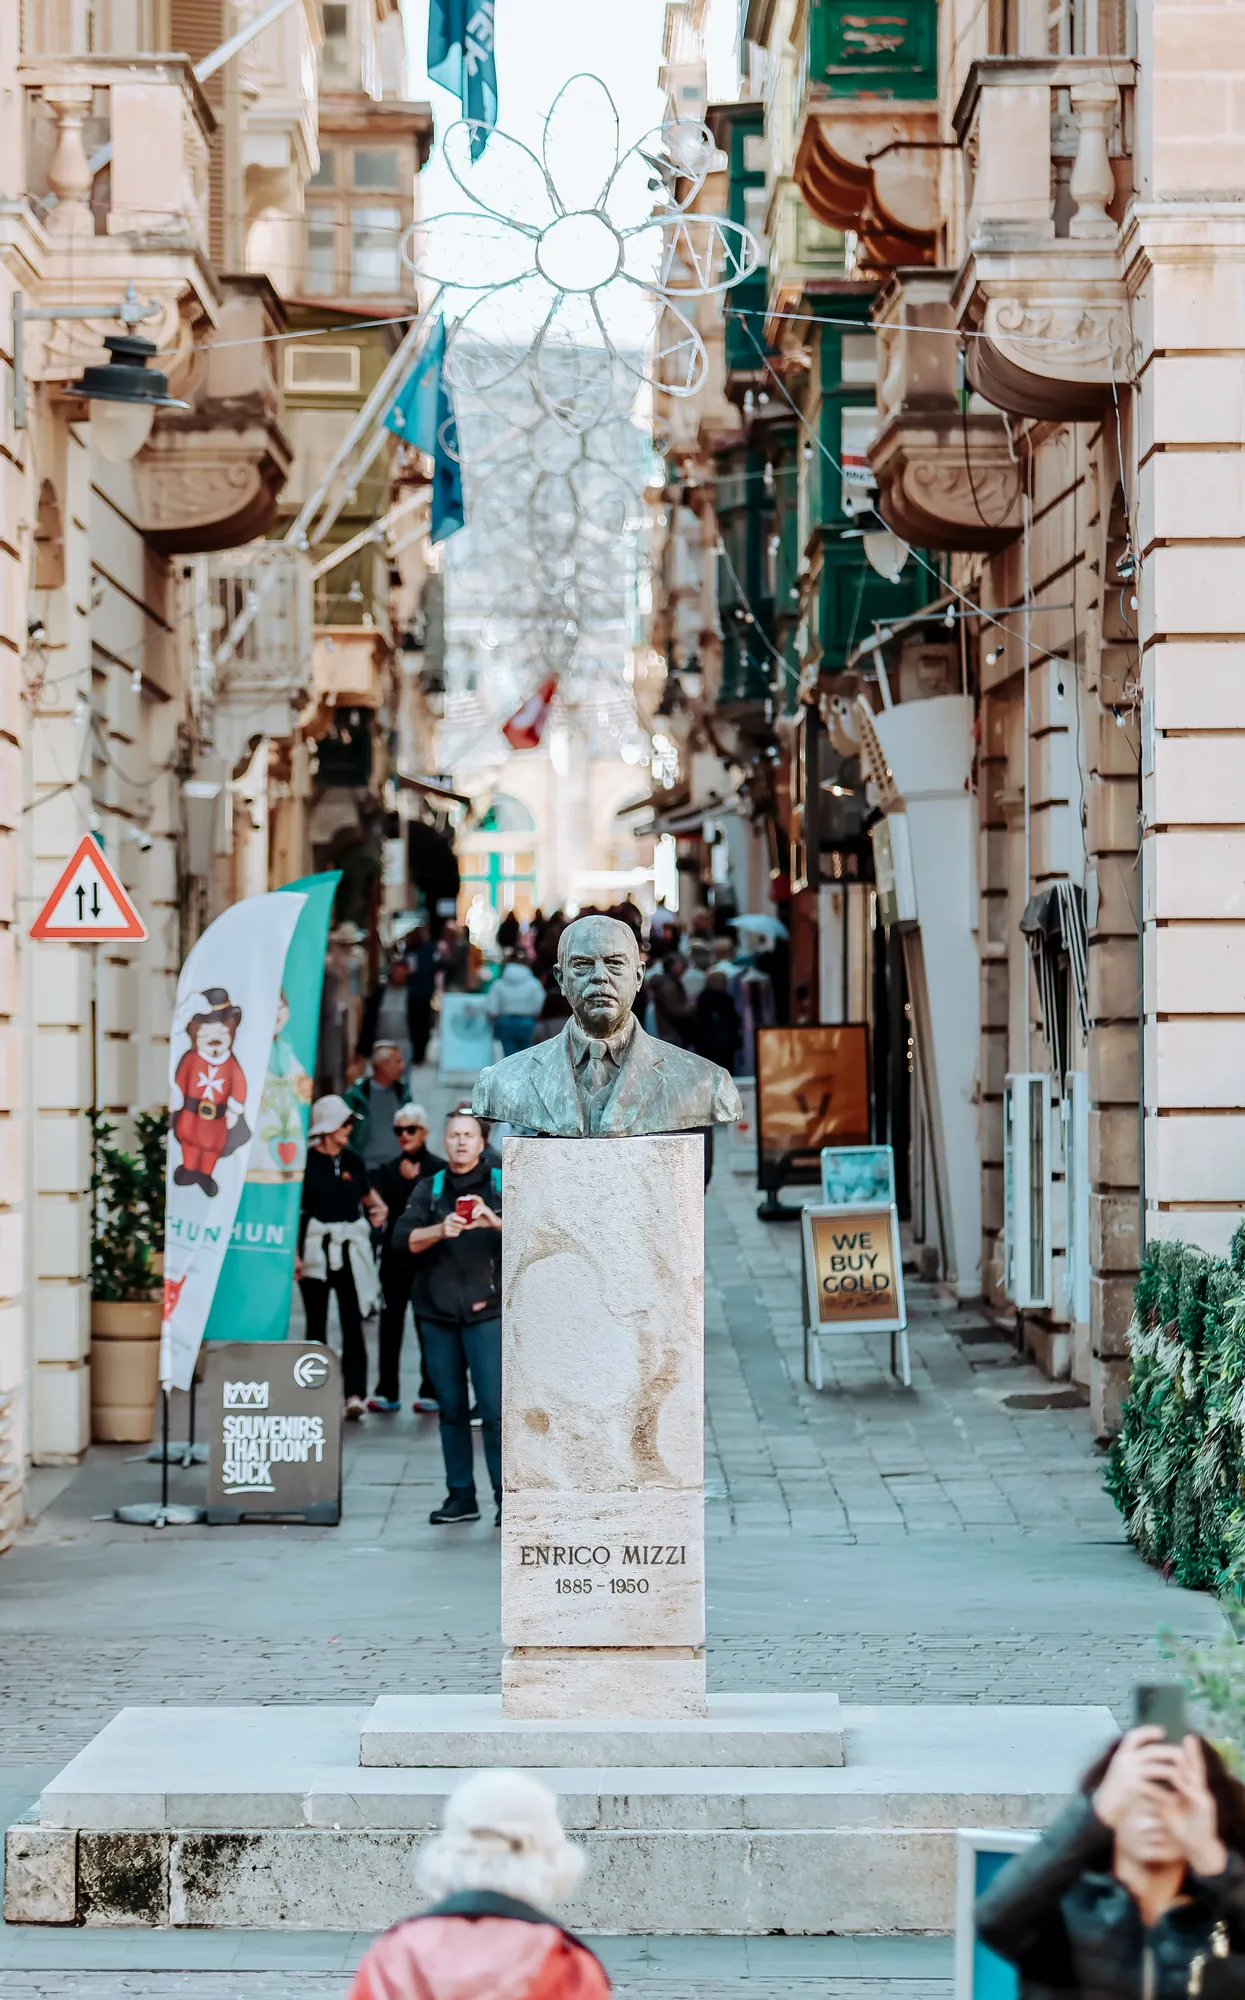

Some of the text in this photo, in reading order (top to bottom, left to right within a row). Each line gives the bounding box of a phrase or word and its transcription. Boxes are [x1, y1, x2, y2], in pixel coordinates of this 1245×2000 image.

[832, 1231, 873, 1251] WE
[830, 1253, 879, 1272] BUY
[823, 1273, 890, 1294] GOLD
[222, 1415, 323, 1440] SOUVENIRS
[222, 1438, 326, 1462] THAT DON'T
[222, 1460, 272, 1485] SUCK
[519, 1545, 687, 1566] ENRICO MIZZI
